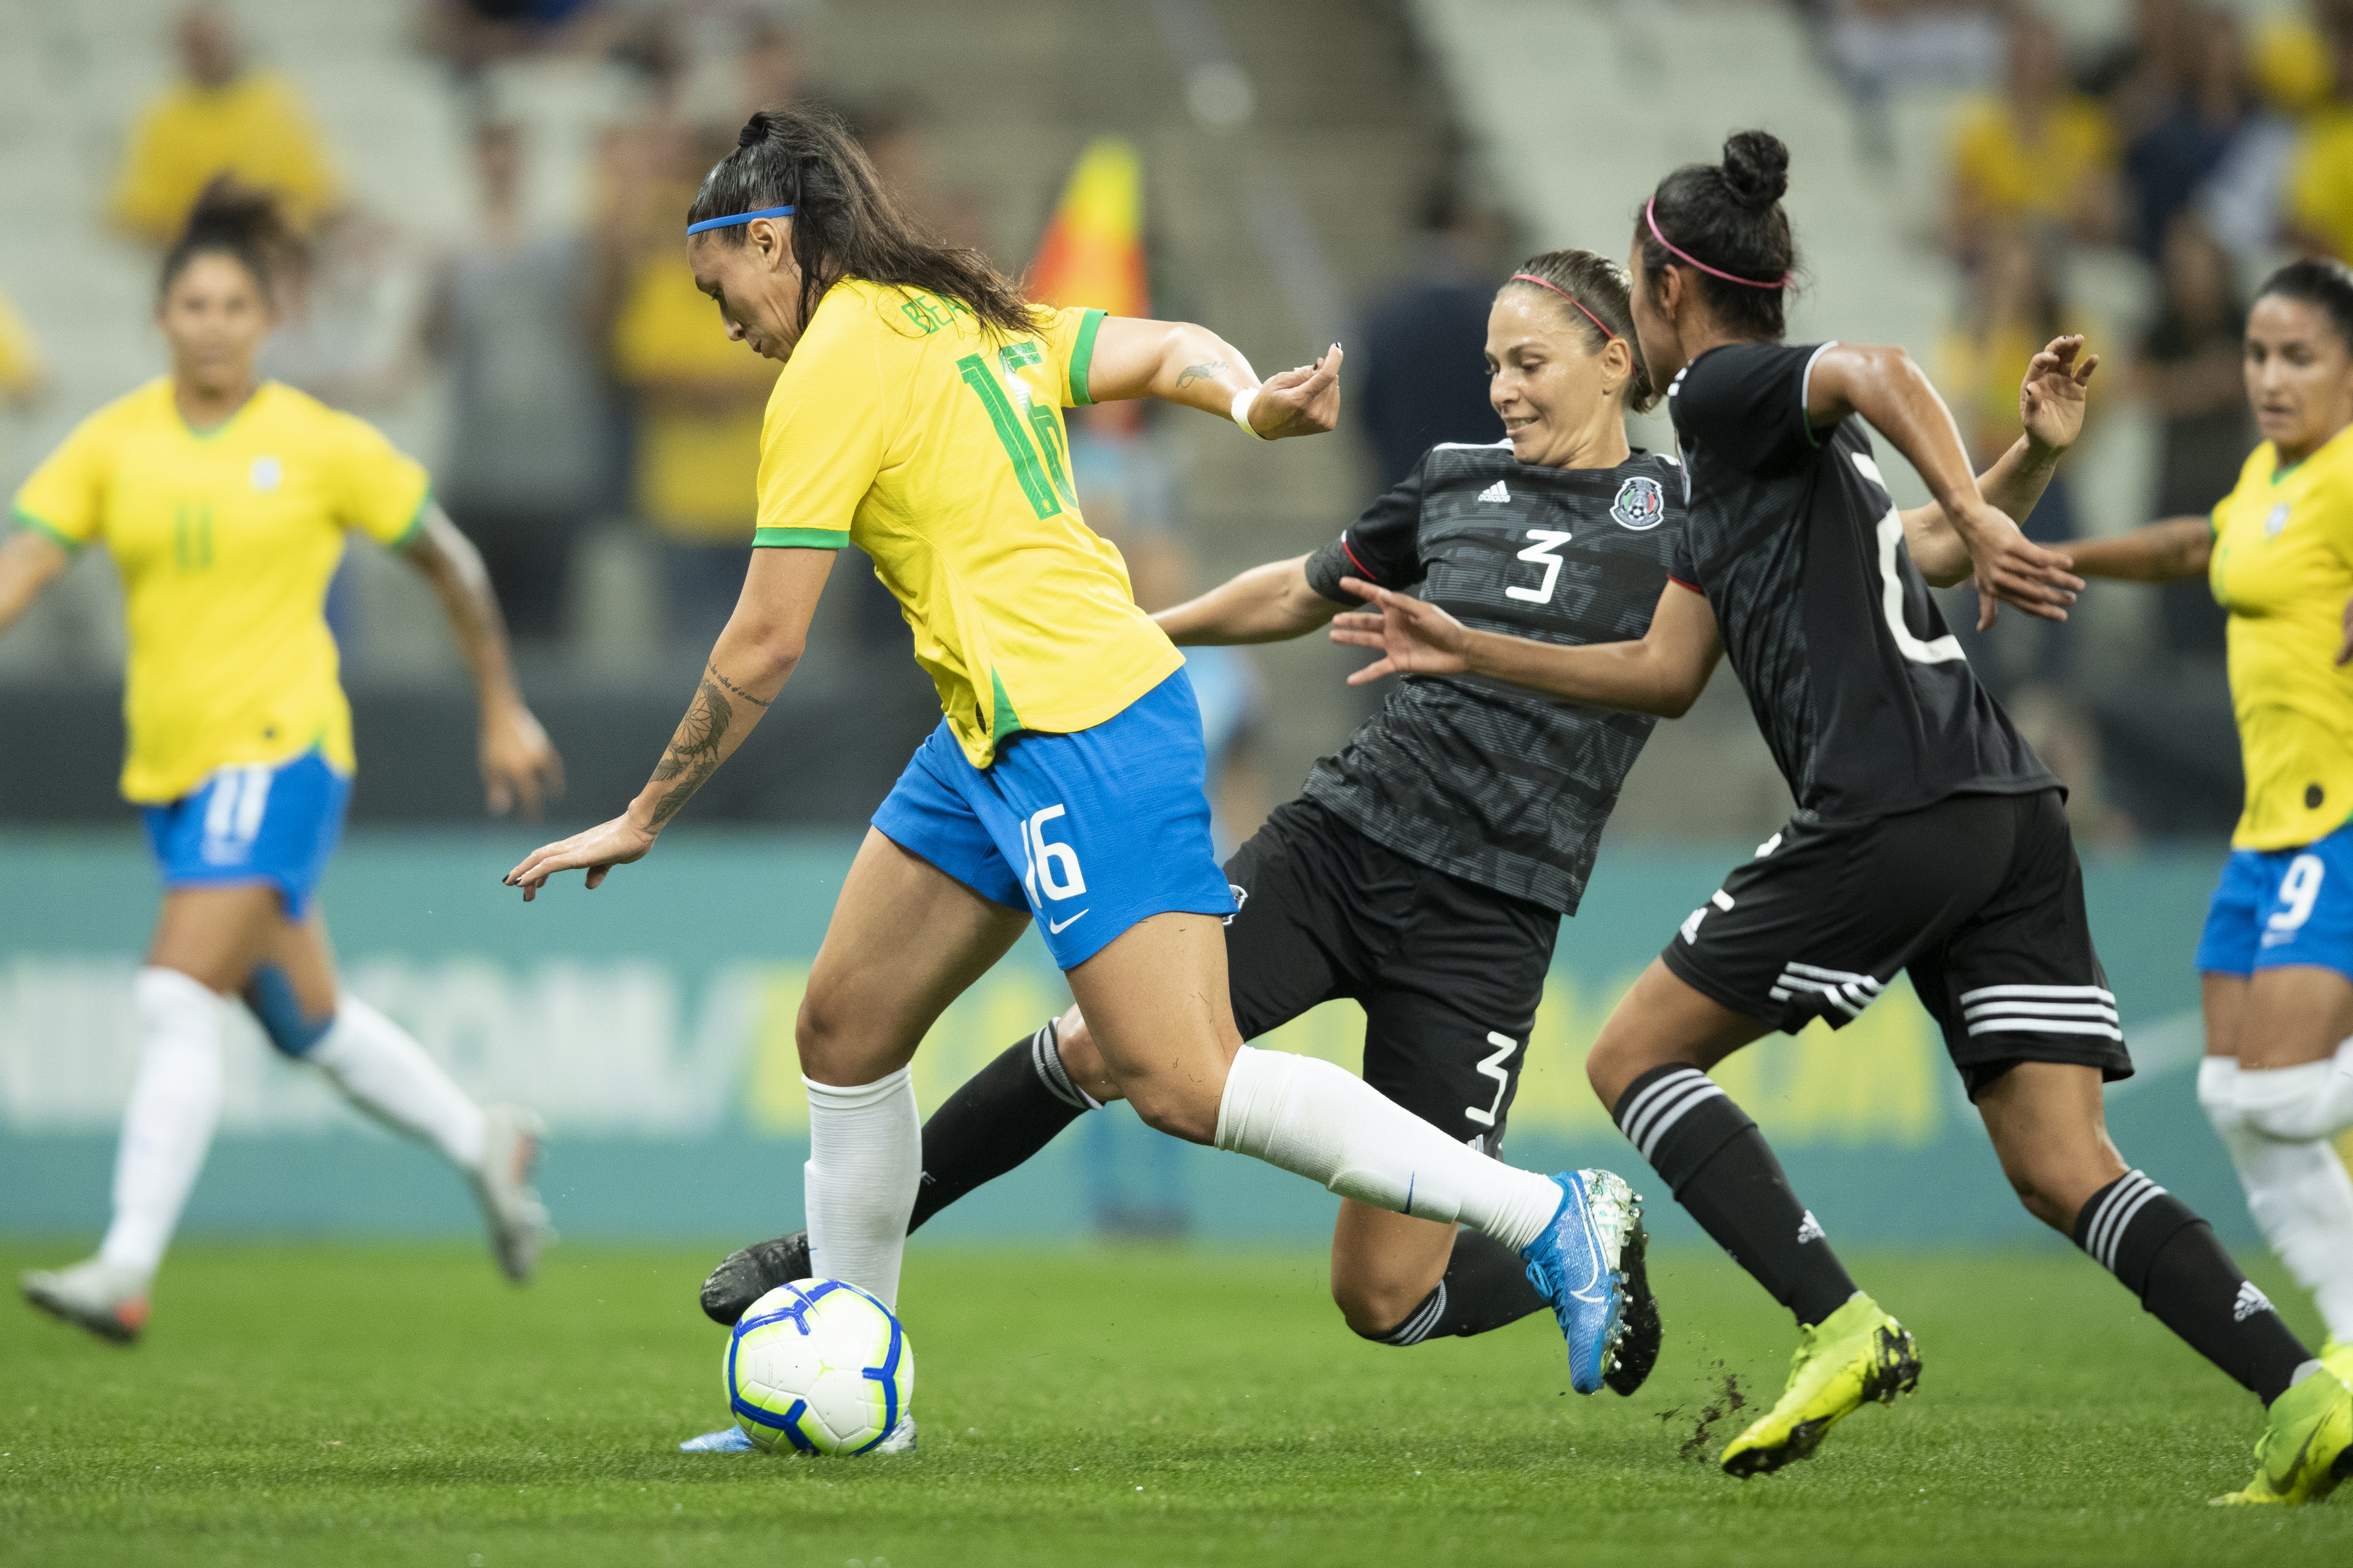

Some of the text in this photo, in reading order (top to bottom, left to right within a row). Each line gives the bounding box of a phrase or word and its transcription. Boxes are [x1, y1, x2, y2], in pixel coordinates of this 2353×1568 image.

[901, 292, 972, 335] BEA
[955, 341, 1079, 521] 16
[174, 501, 213, 574] 11
[1505, 529, 1573, 604] 3
[204, 764, 273, 844] 11
[1020, 803, 1087, 909] 16
[2267, 854, 2324, 930] 9
[1465, 1031, 1518, 1127] 3
